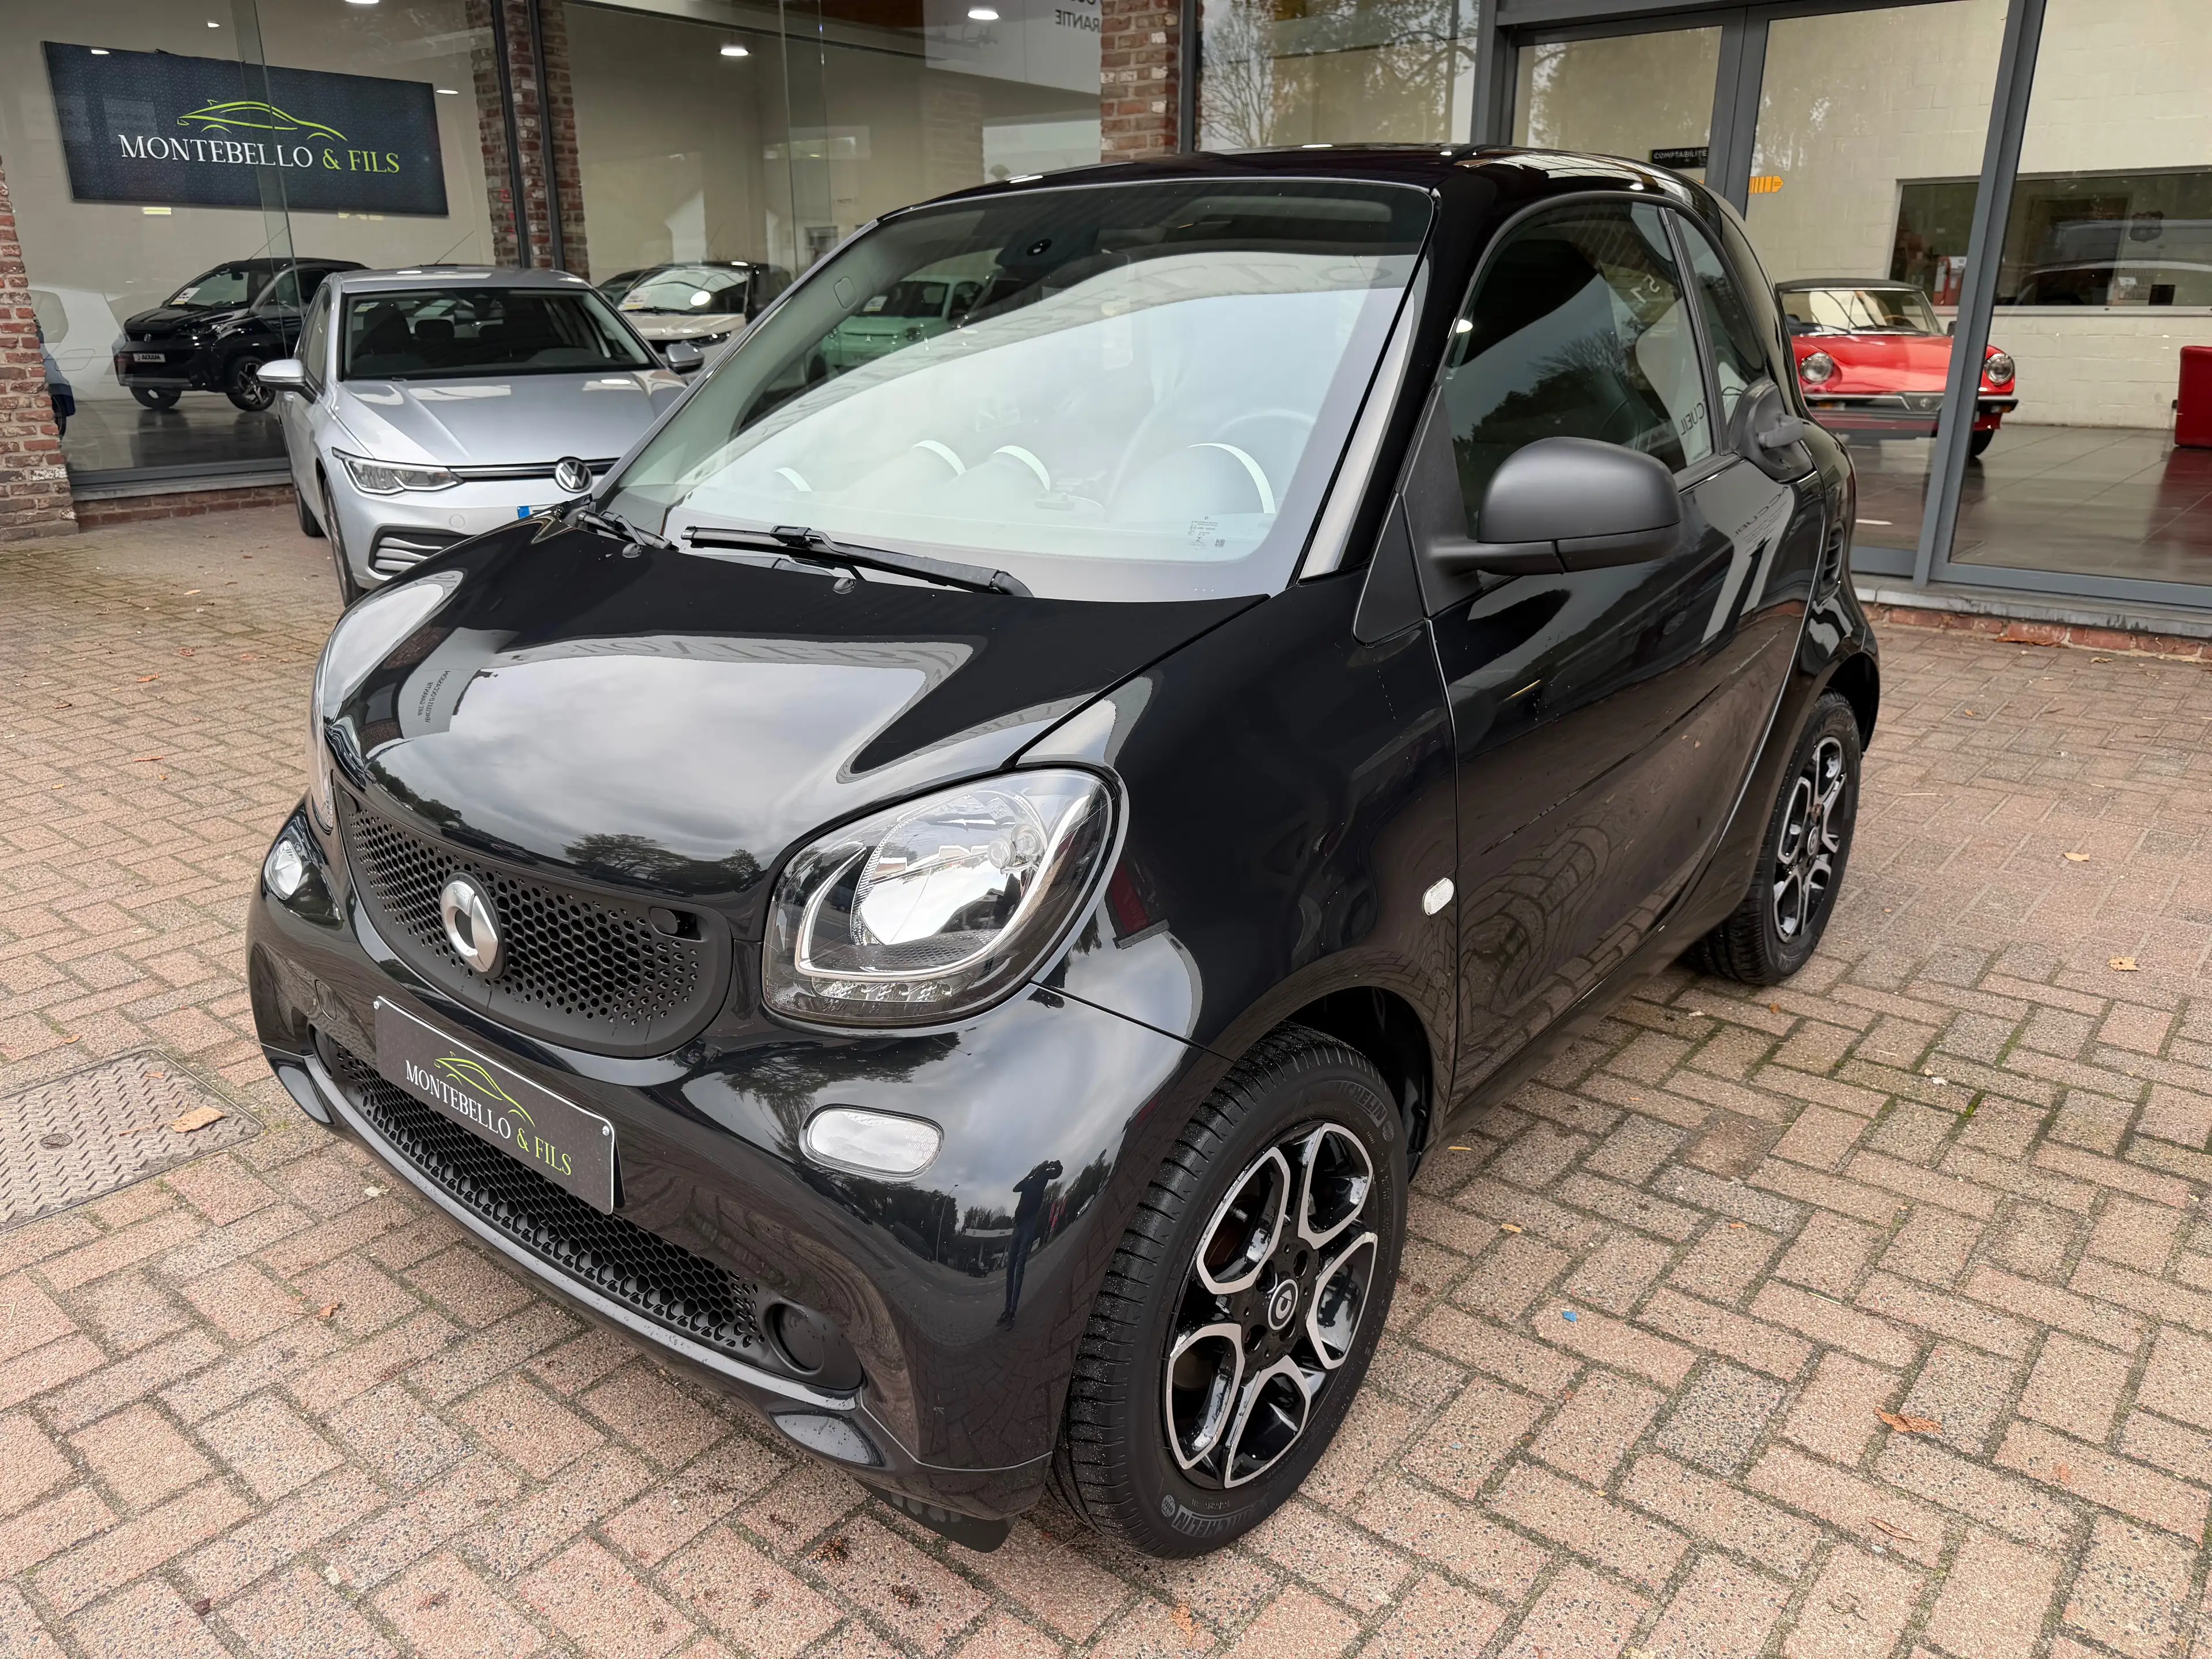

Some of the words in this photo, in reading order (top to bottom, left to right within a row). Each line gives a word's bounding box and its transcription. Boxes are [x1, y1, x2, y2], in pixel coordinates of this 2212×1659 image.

[118, 134, 313, 168] MONTEBELLO
[323, 149, 341, 170] &
[348, 150, 400, 173] FILS
[406, 1060, 511, 1139] MONTEBELLO
[517, 1128, 529, 1152] &
[535, 1136, 571, 1176] FILS
